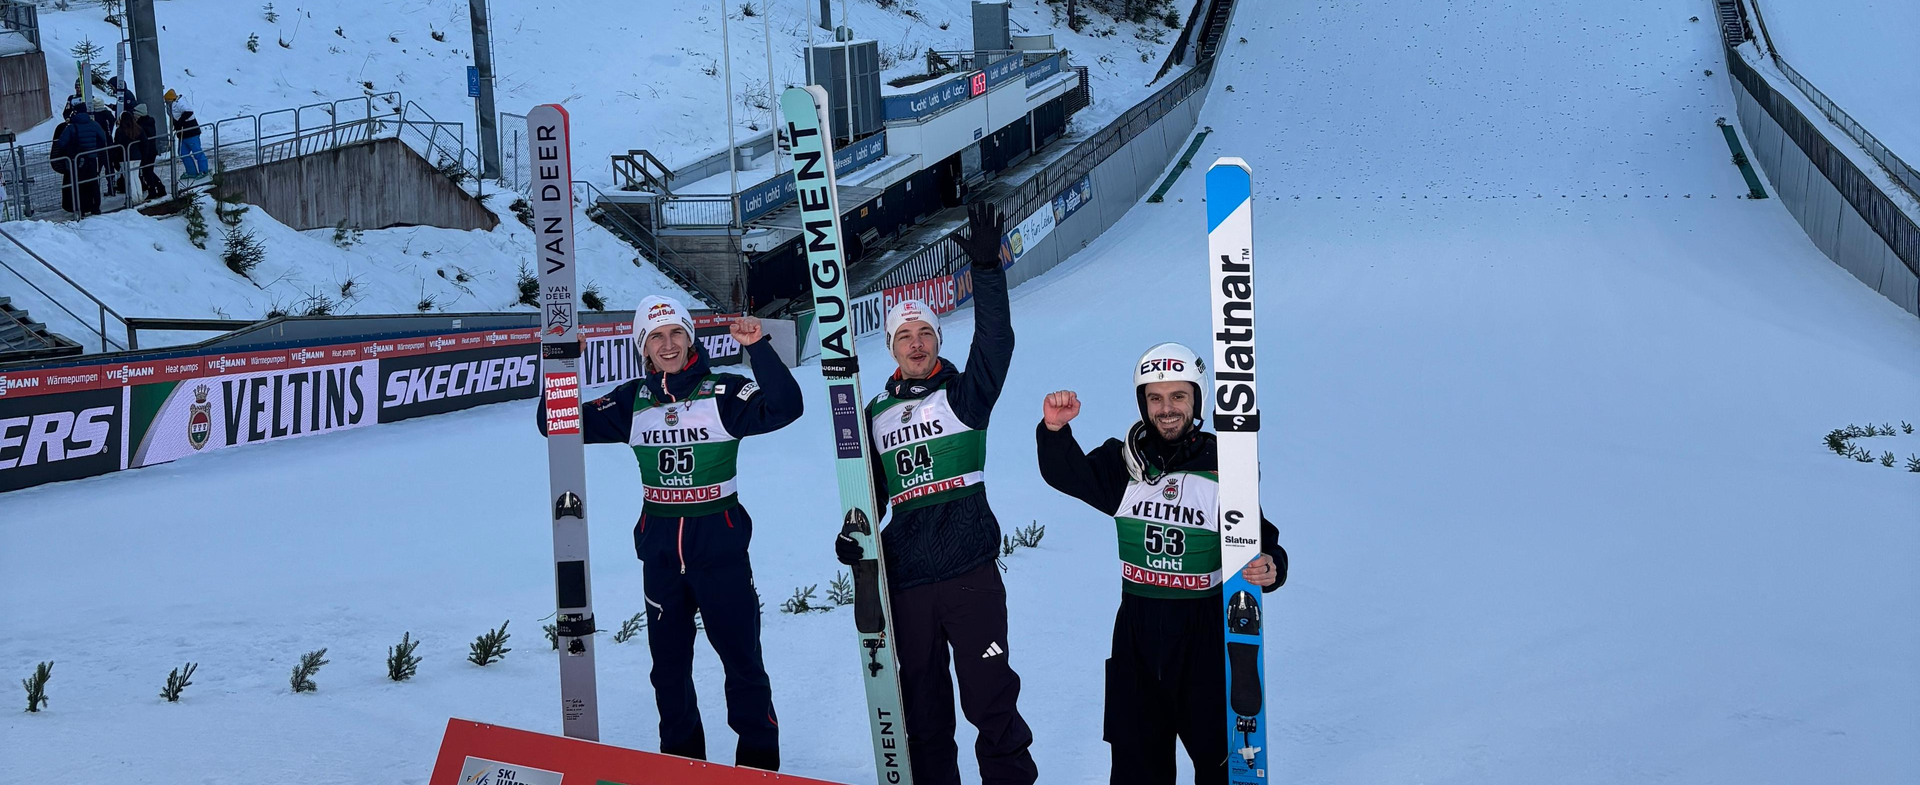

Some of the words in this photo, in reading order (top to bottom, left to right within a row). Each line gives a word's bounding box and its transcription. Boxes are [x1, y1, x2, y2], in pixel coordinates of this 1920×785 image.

[536, 125, 561, 202] DEER
[745, 193, 763, 213] Lahti
[765, 185, 781, 203] Lahti
[543, 217, 566, 275] VAN
[788, 121, 850, 357] AUGMENT
[546, 292, 571, 300] DEER
[648, 309, 662, 320] Red
[662, 308, 676, 316] Bull
[850, 296, 881, 337] TINS
[429, 336, 456, 350] VIESSMANN
[1216, 254, 1255, 414] Slatnar
[363, 342, 394, 357] VIESSMANN
[698, 333, 741, 359] HERS
[208, 356, 247, 372] VIESSMANN
[250, 354, 286, 365] Wärmepumpen
[291, 348, 325, 364] VIESSMANN
[332, 349, 342, 358] Heat
[342, 348, 357, 358] pumps
[582, 336, 646, 386] VELTIN
[47, 373, 98, 386] Wärmepumpen
[106, 365, 155, 384] VIESSMANN
[165, 364, 179, 374] Heat
[180, 363, 199, 373] pumps
[382, 355, 538, 409] SKECHERS
[545, 375, 578, 389] Kronen
[546, 387, 578, 401] Zeitung
[222, 365, 364, 446] VELTINS
[546, 406, 579, 419] Kronen
[548, 418, 580, 432] Zeitung
[882, 419, 944, 449] VELTINS
[642, 427, 709, 444] VELTINS
[658, 446, 695, 475] 65
[895, 443, 933, 476] 64
[659, 475, 693, 486] Lahti
[901, 469, 934, 488] Lahti
[644, 486, 720, 501] BAUHAUS
[1132, 501, 1205, 526] VELTINS
[1144, 523, 1186, 557] 53
[1225, 535, 1257, 545] Slatnar
[1146, 555, 1183, 571] Lahti
[1124, 563, 1210, 588] BAUHAUS
[497, 769, 516, 781] SKI
